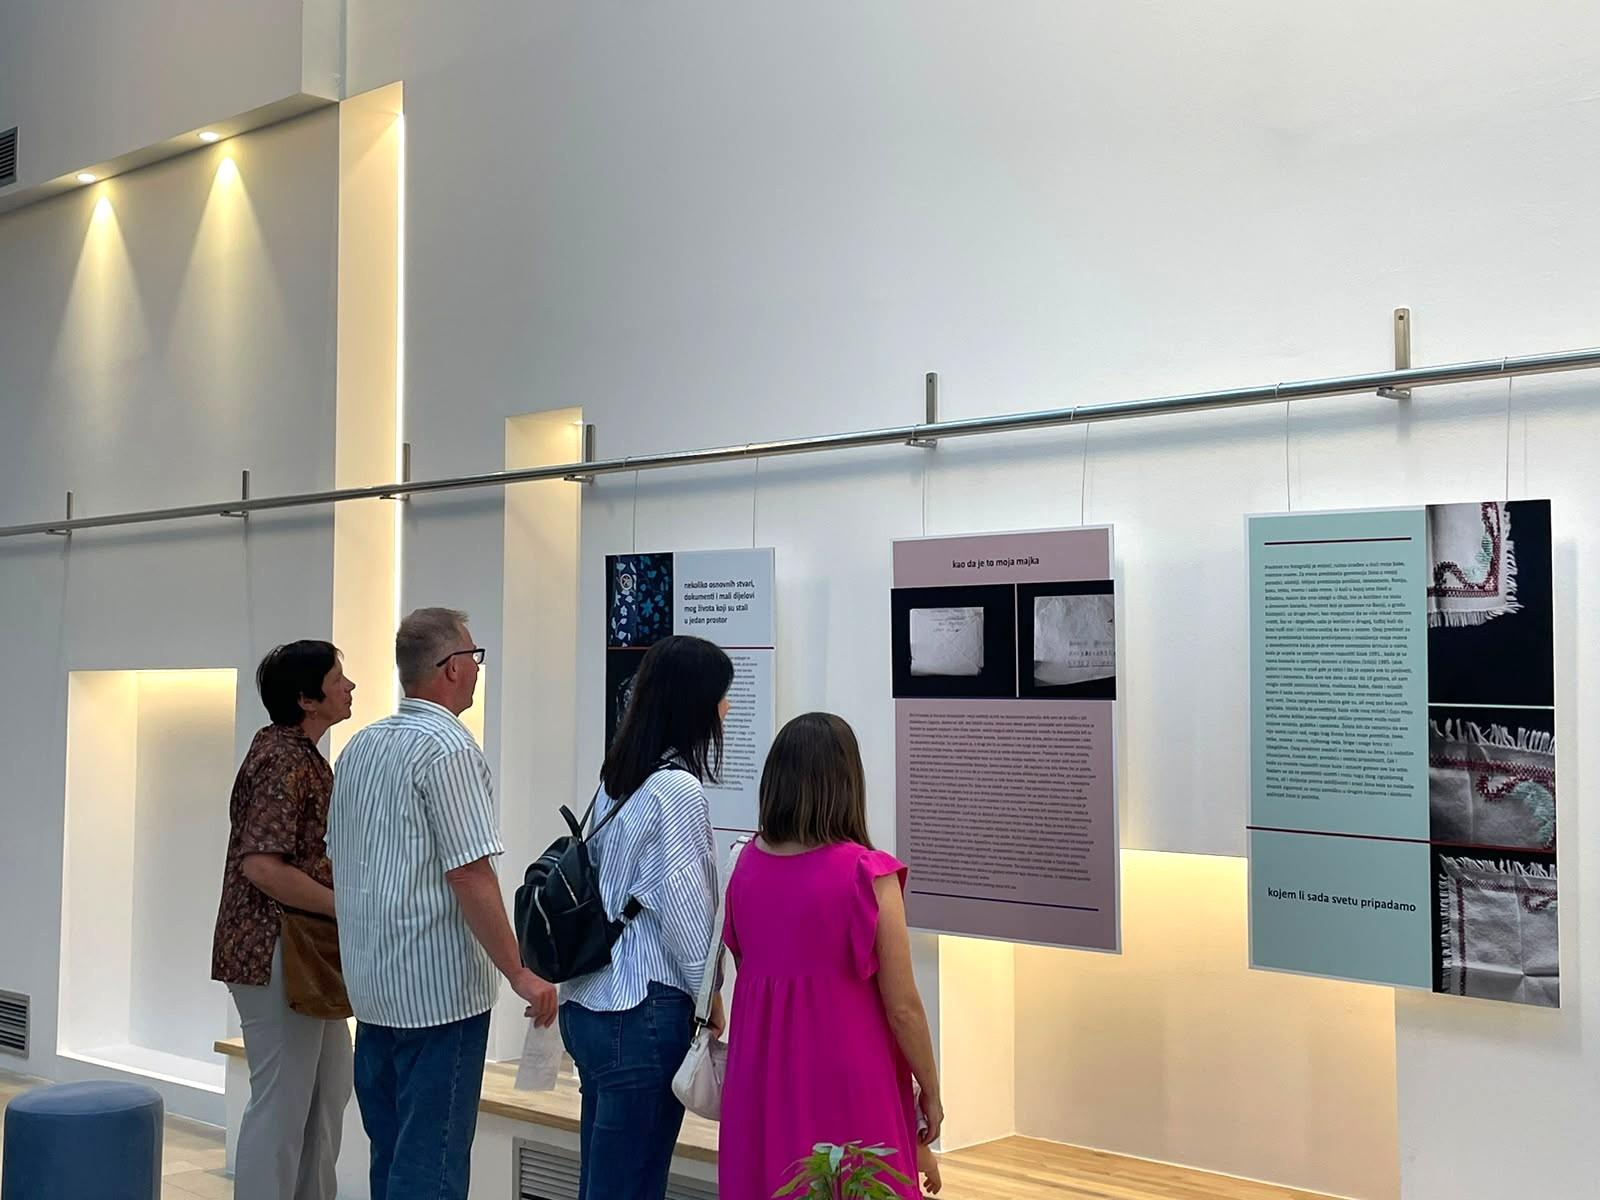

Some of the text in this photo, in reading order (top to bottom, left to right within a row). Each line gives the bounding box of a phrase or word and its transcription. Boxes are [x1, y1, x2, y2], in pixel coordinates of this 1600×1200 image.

[952, 556, 1040, 570] kao da je to moja majka
[683, 579, 755, 589] nekoliko osnovnih stvari,
[683, 593, 715, 601] dokumenti
[719, 592, 732, 600] mali
[733, 591, 755, 601] dijelovi
[697, 604, 715, 612] života
[716, 604, 727, 613] koji
[688, 617, 706, 625] jedan
[1267, 887, 1417, 912] kojem li sada svetu pripadamo
